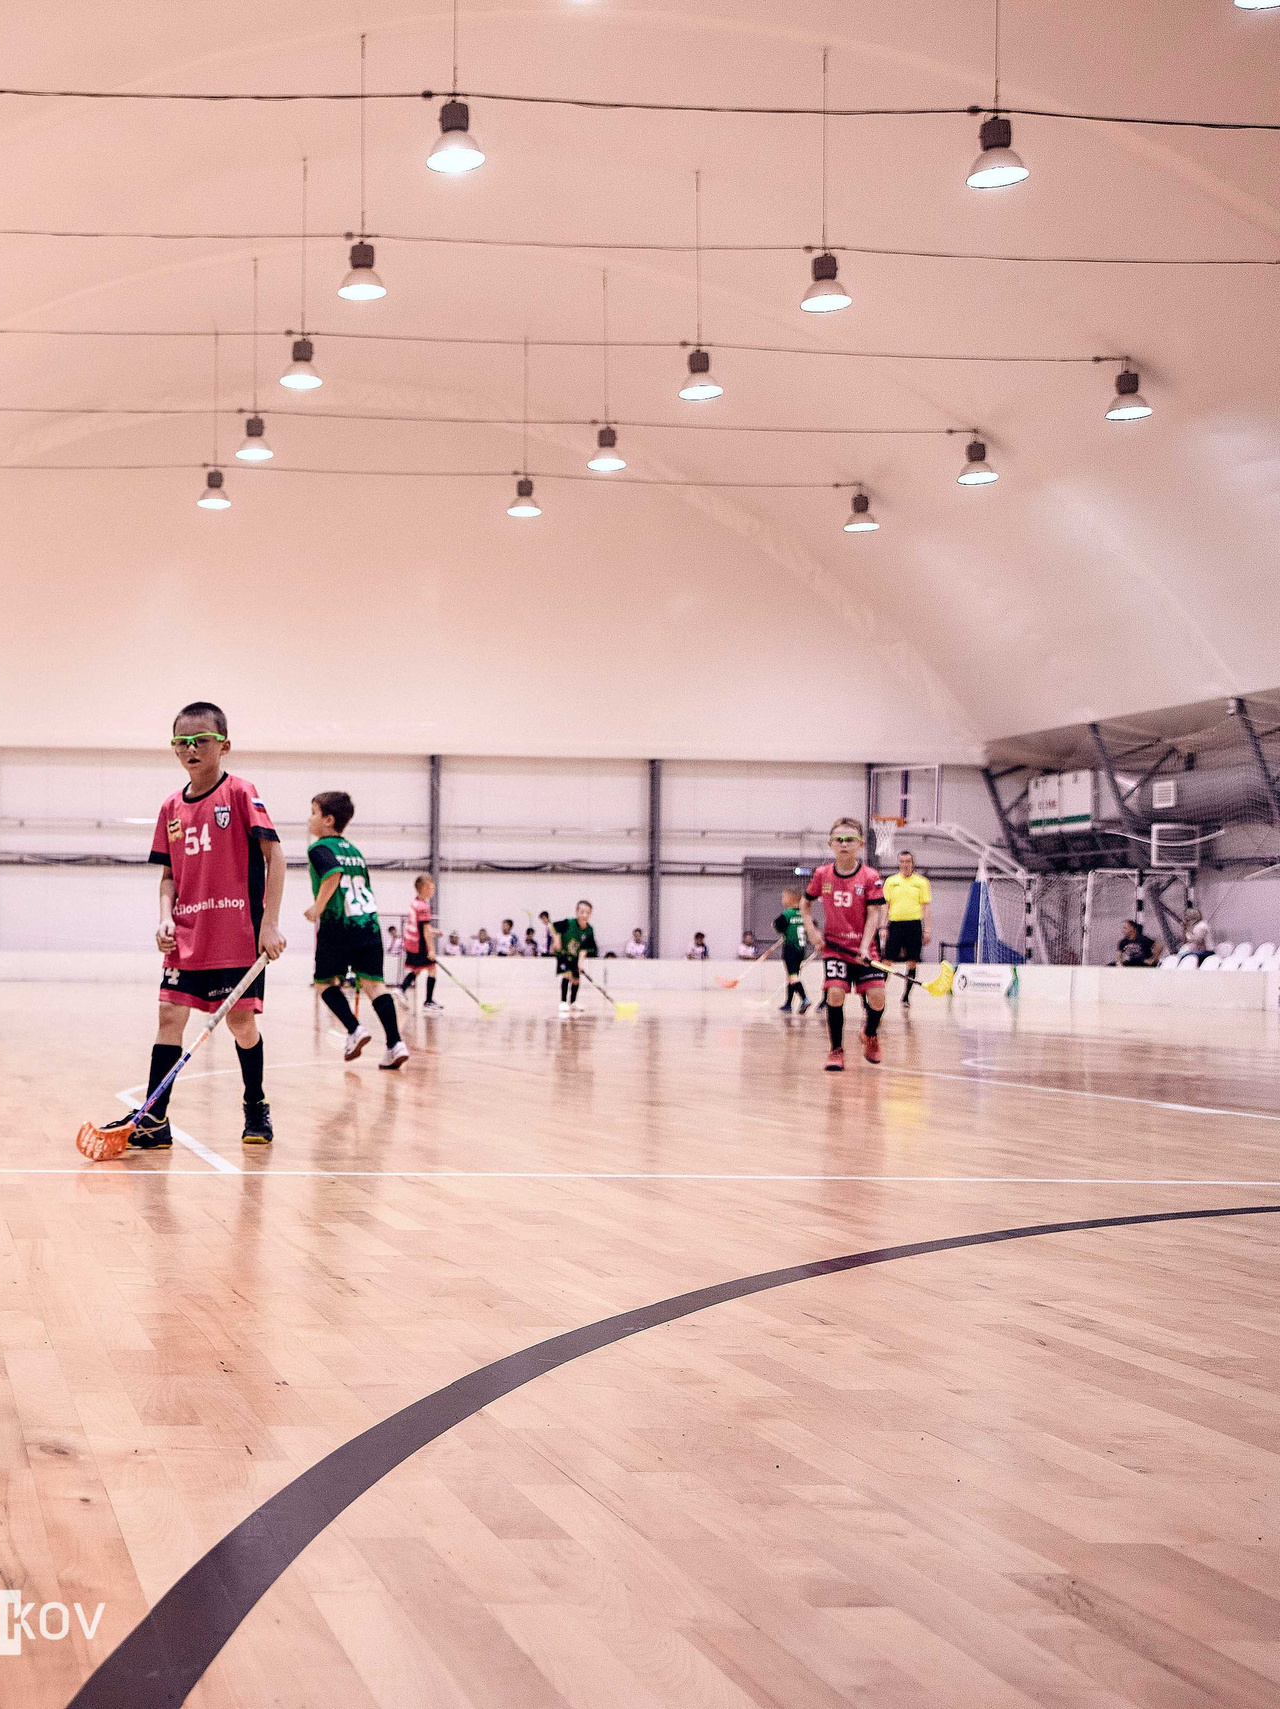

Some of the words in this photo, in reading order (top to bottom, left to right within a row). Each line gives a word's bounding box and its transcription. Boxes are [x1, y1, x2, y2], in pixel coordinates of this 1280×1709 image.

[185, 823, 212, 856] 54
[833, 890, 853, 908] 53
[826, 960, 848, 979] 53
